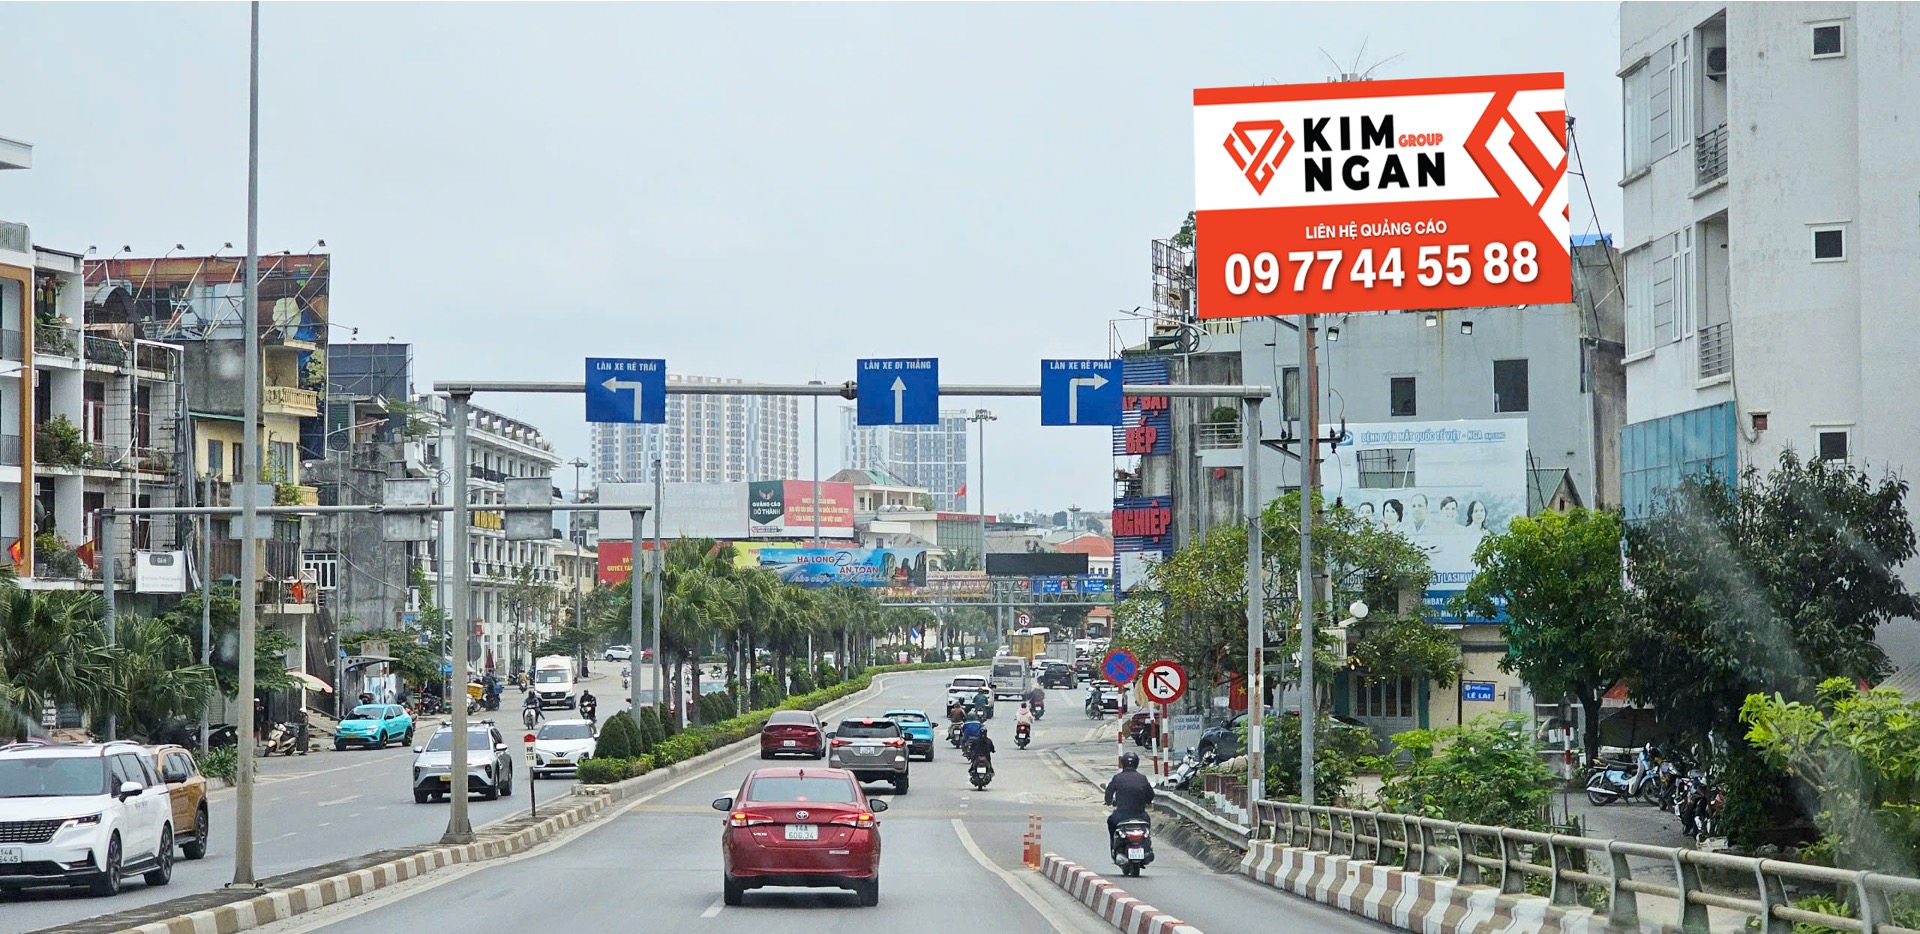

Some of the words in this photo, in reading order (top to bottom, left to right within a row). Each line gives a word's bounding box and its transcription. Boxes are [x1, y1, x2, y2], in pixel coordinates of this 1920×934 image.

[1303, 114, 1395, 152] KIM
[1398, 133, 1444, 148] GROUP
[1304, 152, 1446, 192] NGAN
[1305, 223, 1336, 239] LIÊN
[1338, 221, 1358, 239] HỆ
[1360, 219, 1412, 238] QUẢNG
[1414, 219, 1447, 235] CÁO
[1224, 252, 1280, 295] 09
[1288, 250, 1343, 291] 77
[1349, 247, 1405, 289] 44
[1417, 244, 1472, 287] 55
[1483, 240, 1539, 285] 88
[596, 361, 612, 371] LÀN
[614, 362, 624, 371] XE
[639, 361, 657, 371] TRÁI
[864, 360, 880, 370] LÀN
[882, 361, 893, 370] XE
[895, 361, 903, 369] ĐI
[1050, 360, 1066, 370] LÀN
[1068, 361, 1079, 370] XE
[1093, 360, 1112, 370] PHẢI
[1126, 415, 1157, 453] BẾP
[1361, 431, 1381, 443] BỆNH
[1381, 431, 1398, 443] VIỆN
[1399, 429, 1414, 442] MẮT
[1415, 428, 1435, 443] QUỐC
[1436, 428, 1445, 441] TẾ
[1445, 429, 1461, 443] VIỆT
[1467, 430, 1483, 441] NGA
[1112, 499, 1171, 543] NGHIỆP
[1442, 572, 1466, 583] LASIK
